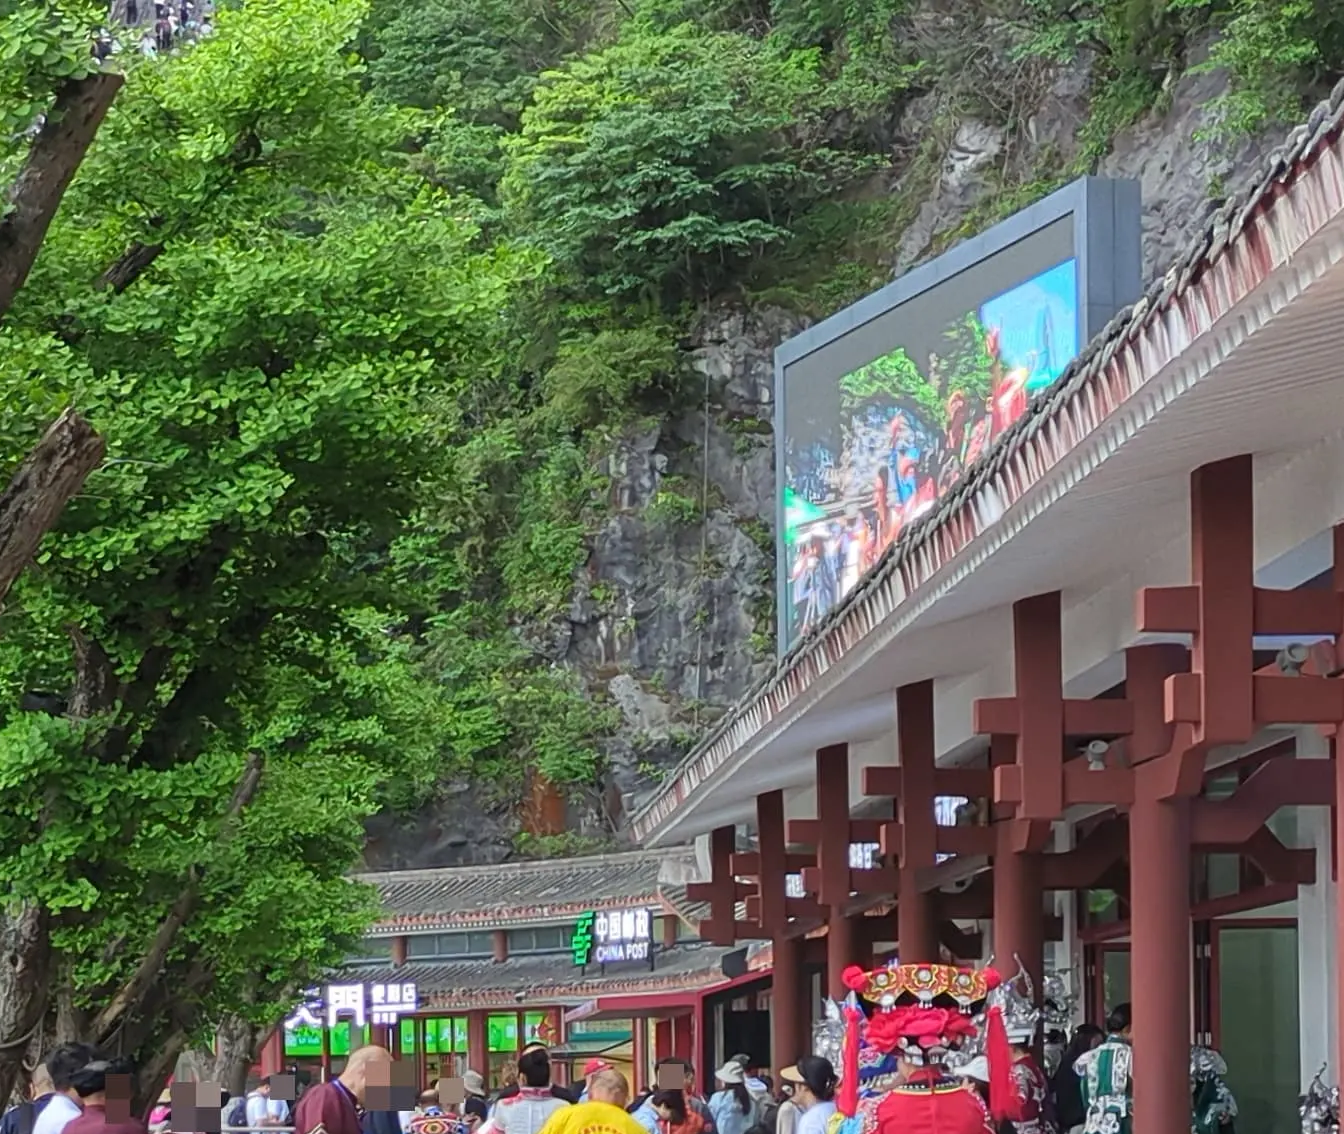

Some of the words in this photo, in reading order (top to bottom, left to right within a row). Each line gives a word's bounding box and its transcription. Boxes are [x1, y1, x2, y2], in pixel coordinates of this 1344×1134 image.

[595, 909, 649, 942] 中国邮政
[596, 945, 625, 963] CHINA
[626, 942, 649, 960] POST
